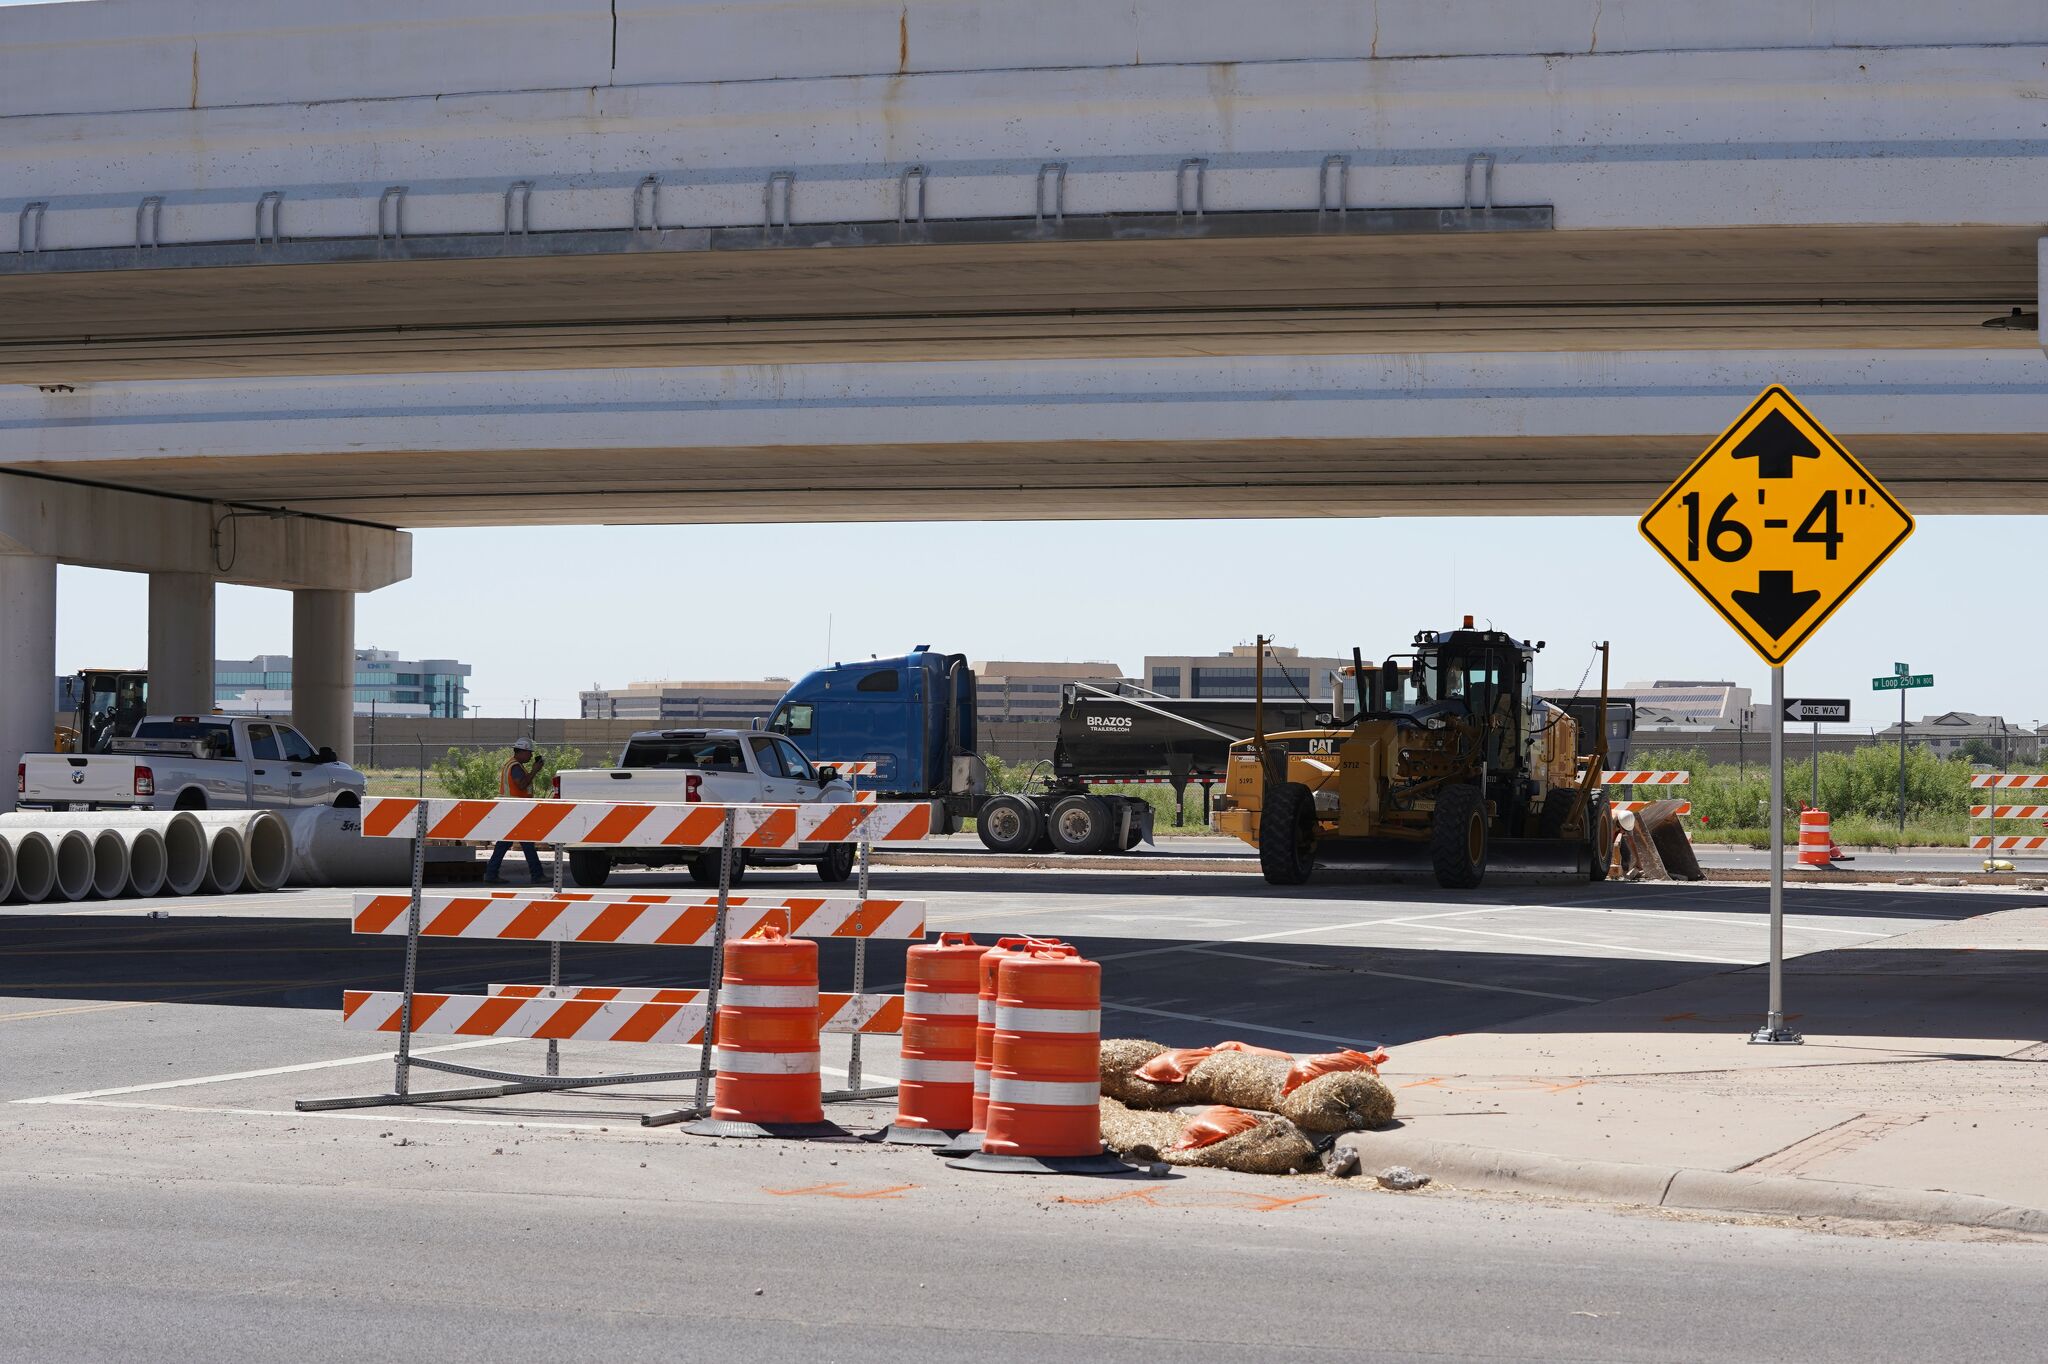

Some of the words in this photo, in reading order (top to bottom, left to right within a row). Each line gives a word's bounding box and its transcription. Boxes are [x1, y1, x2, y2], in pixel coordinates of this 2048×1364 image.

[1881, 679, 1898, 688] Loop
[1900, 677, 1914, 686] 250
[1802, 706, 1819, 714] ONE
[1822, 706, 1839, 714] WAY
[1087, 716, 1132, 727] BRAZOS
[1309, 739, 1334, 755] CAT
[1343, 761, 1360, 769] 5712
